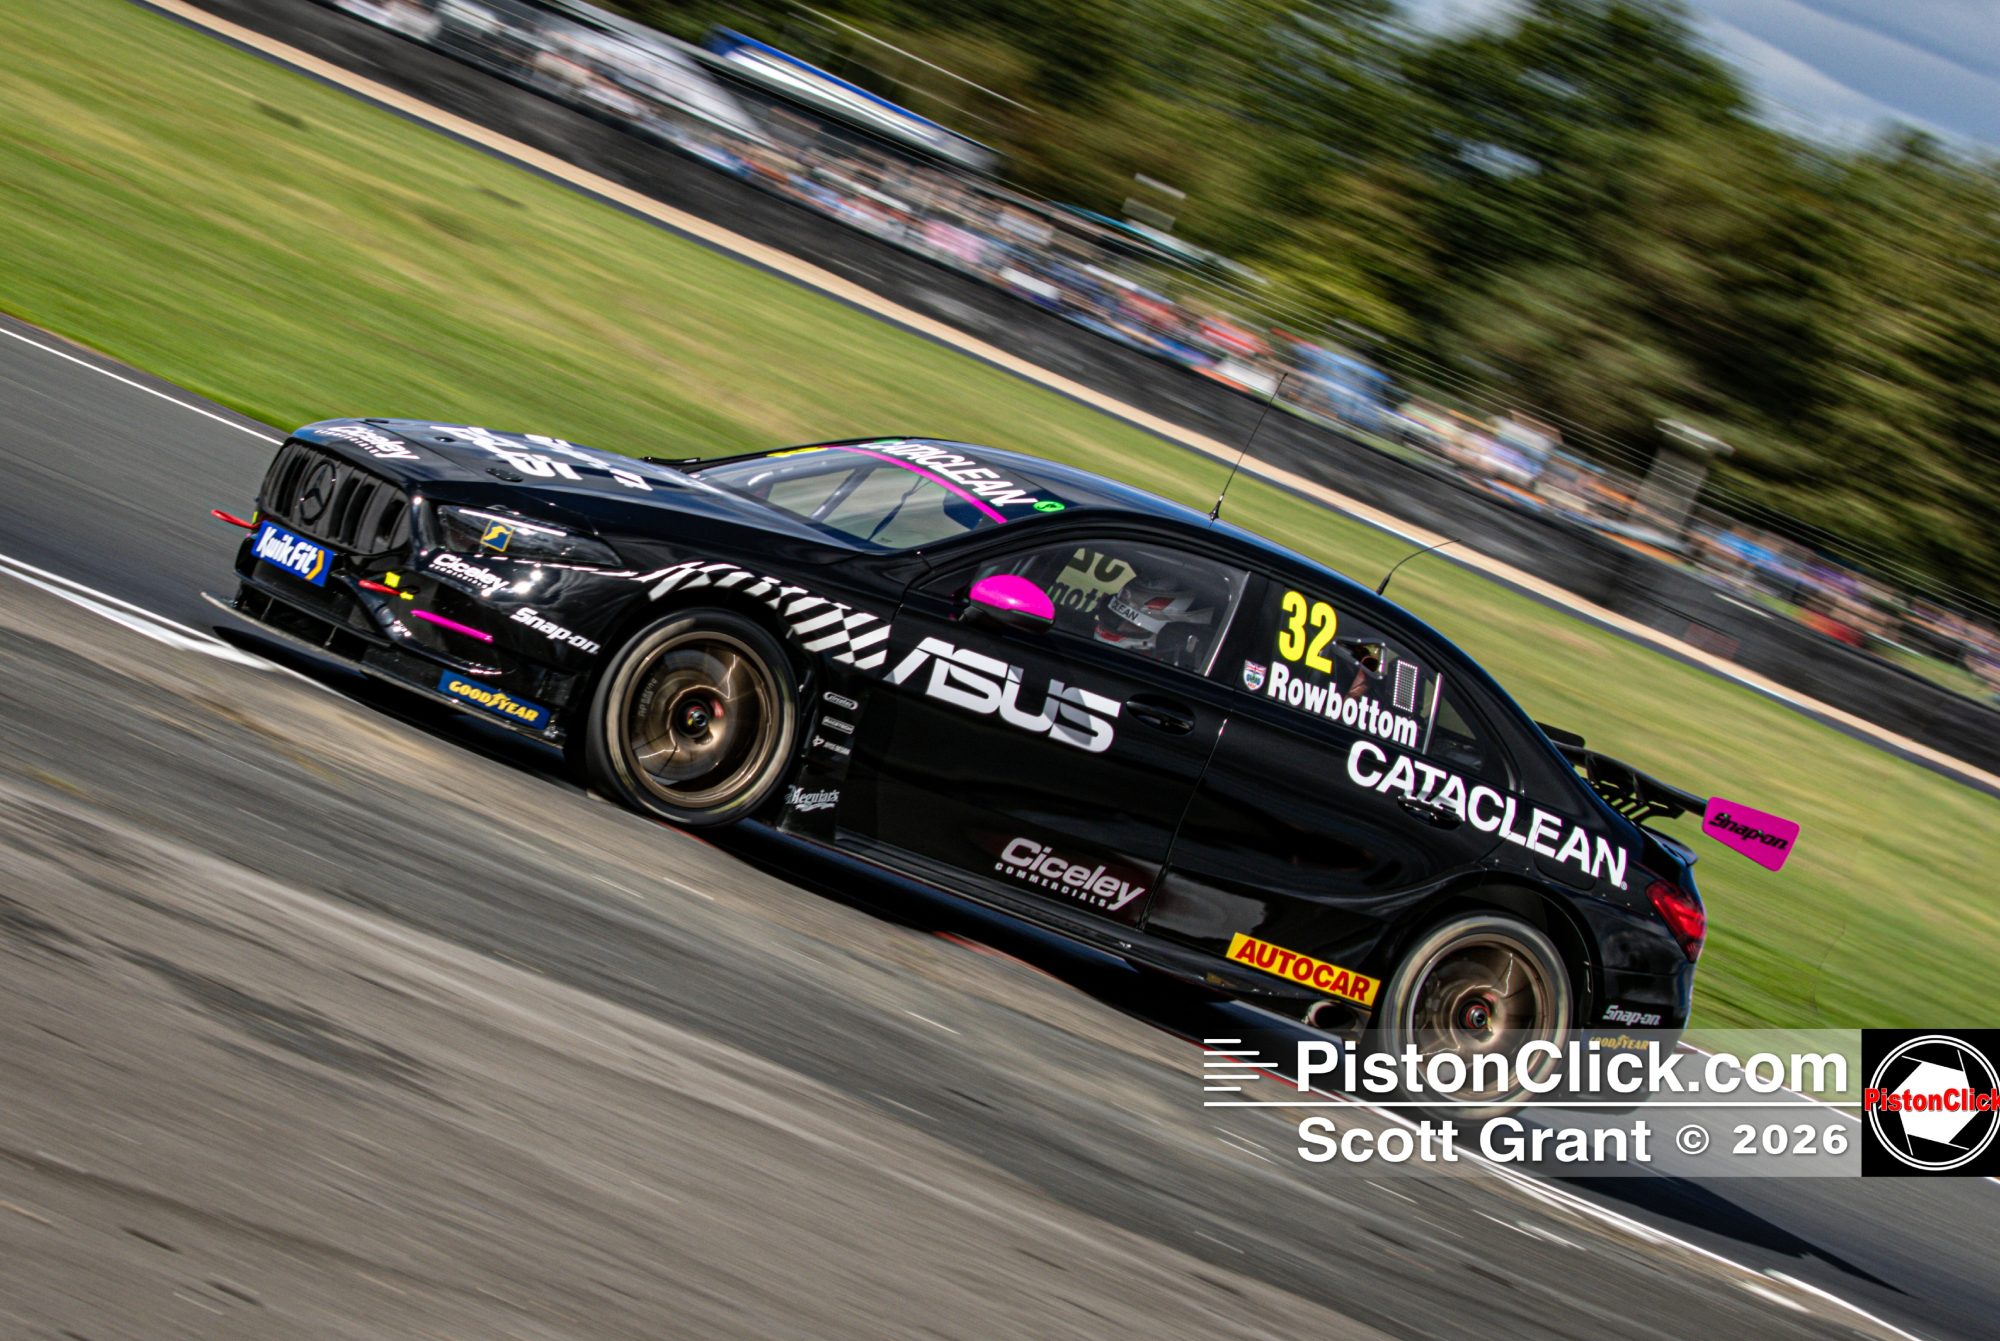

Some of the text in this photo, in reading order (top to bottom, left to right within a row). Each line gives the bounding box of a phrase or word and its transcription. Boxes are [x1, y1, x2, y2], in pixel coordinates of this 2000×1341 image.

[433, 553, 510, 597] Ciceley
[509, 606, 601, 655] Snap-on
[1278, 590, 1338, 675] 32
[448, 680, 539, 722] GOODYEAR
[882, 636, 1122, 753] ASUS
[1267, 660, 1418, 749] Rowbottom
[1346, 740, 1628, 888] CATACLEAN
[1708, 811, 1789, 850] Snap-on
[995, 862, 1107, 908] COMMERCIALS
[1000, 837, 1146, 911] Ciceley
[1235, 938, 1371, 1001] AUTOCAR
[1602, 1004, 1662, 1026] Snap-on
